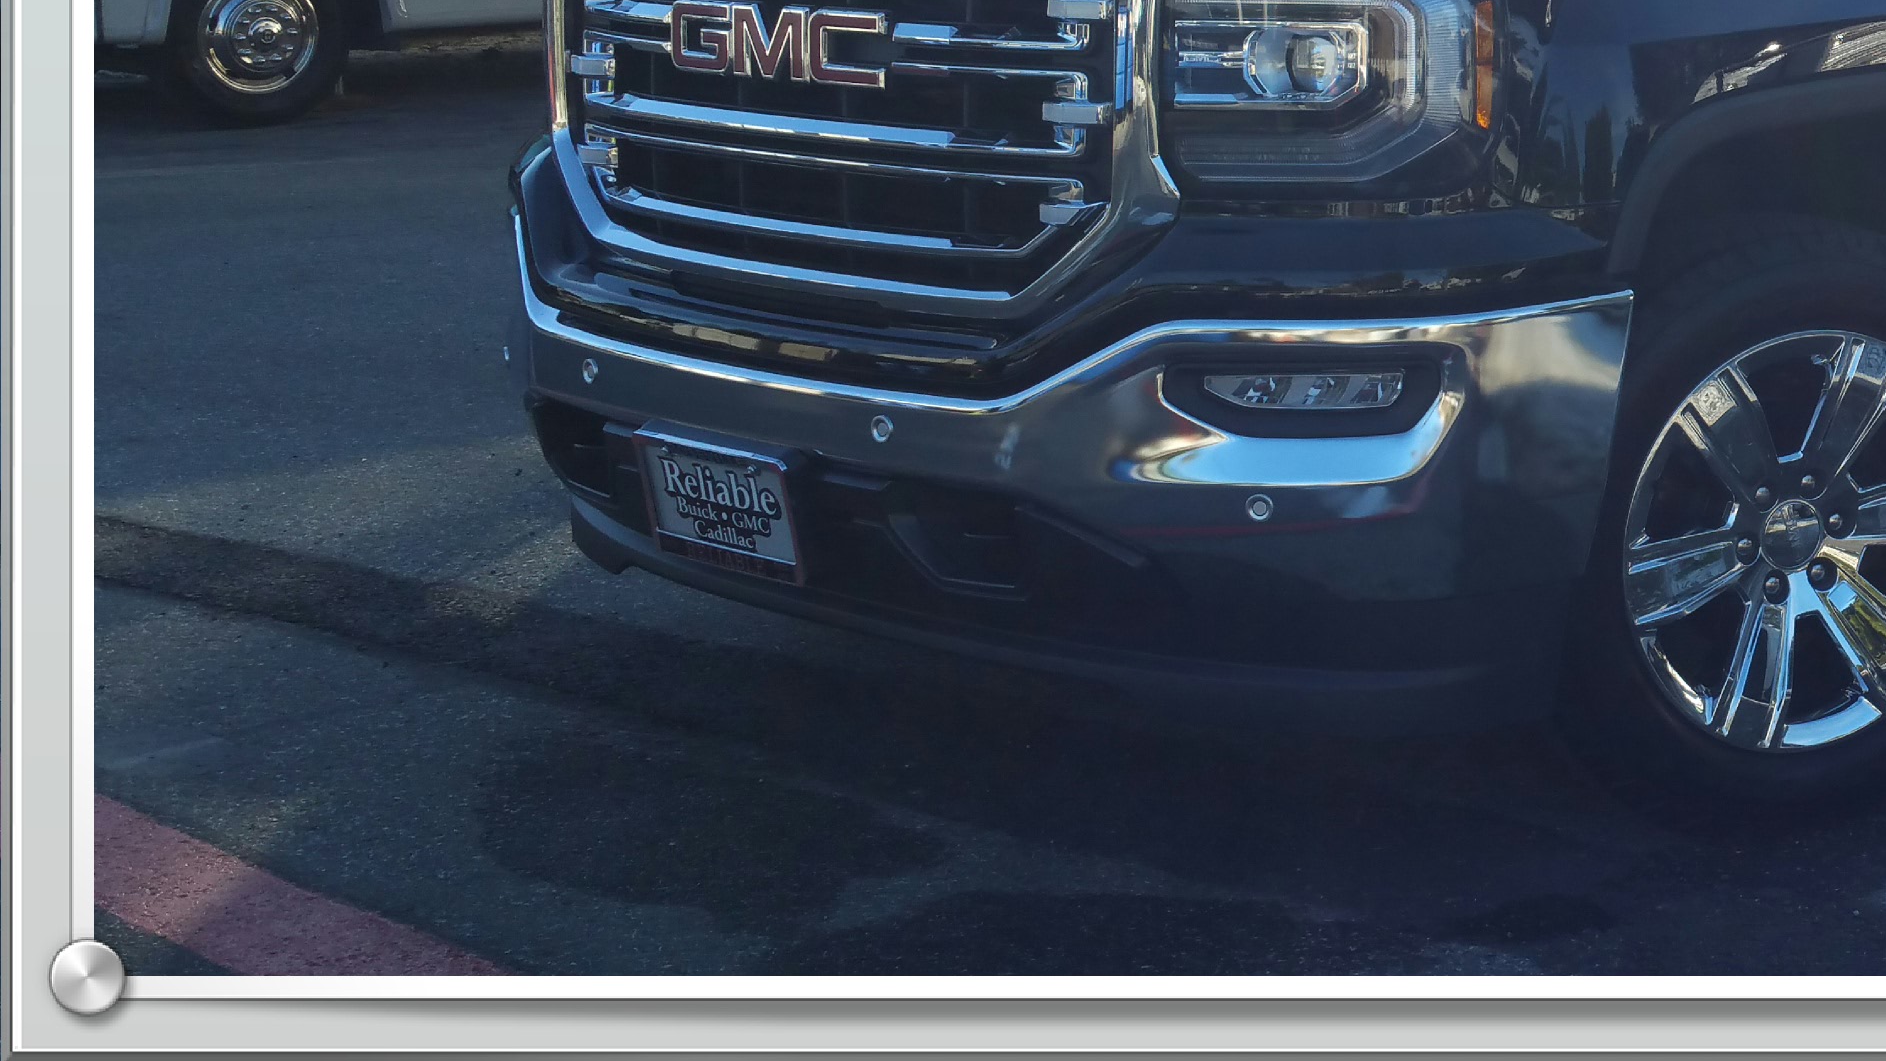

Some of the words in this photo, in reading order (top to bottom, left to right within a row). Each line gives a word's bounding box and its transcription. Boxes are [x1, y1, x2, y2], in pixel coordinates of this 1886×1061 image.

[660, 457, 778, 517] Reliable
[676, 495, 718, 522] Buick
[731, 512, 771, 534] GMC
[694, 519, 755, 549] Cadillac
